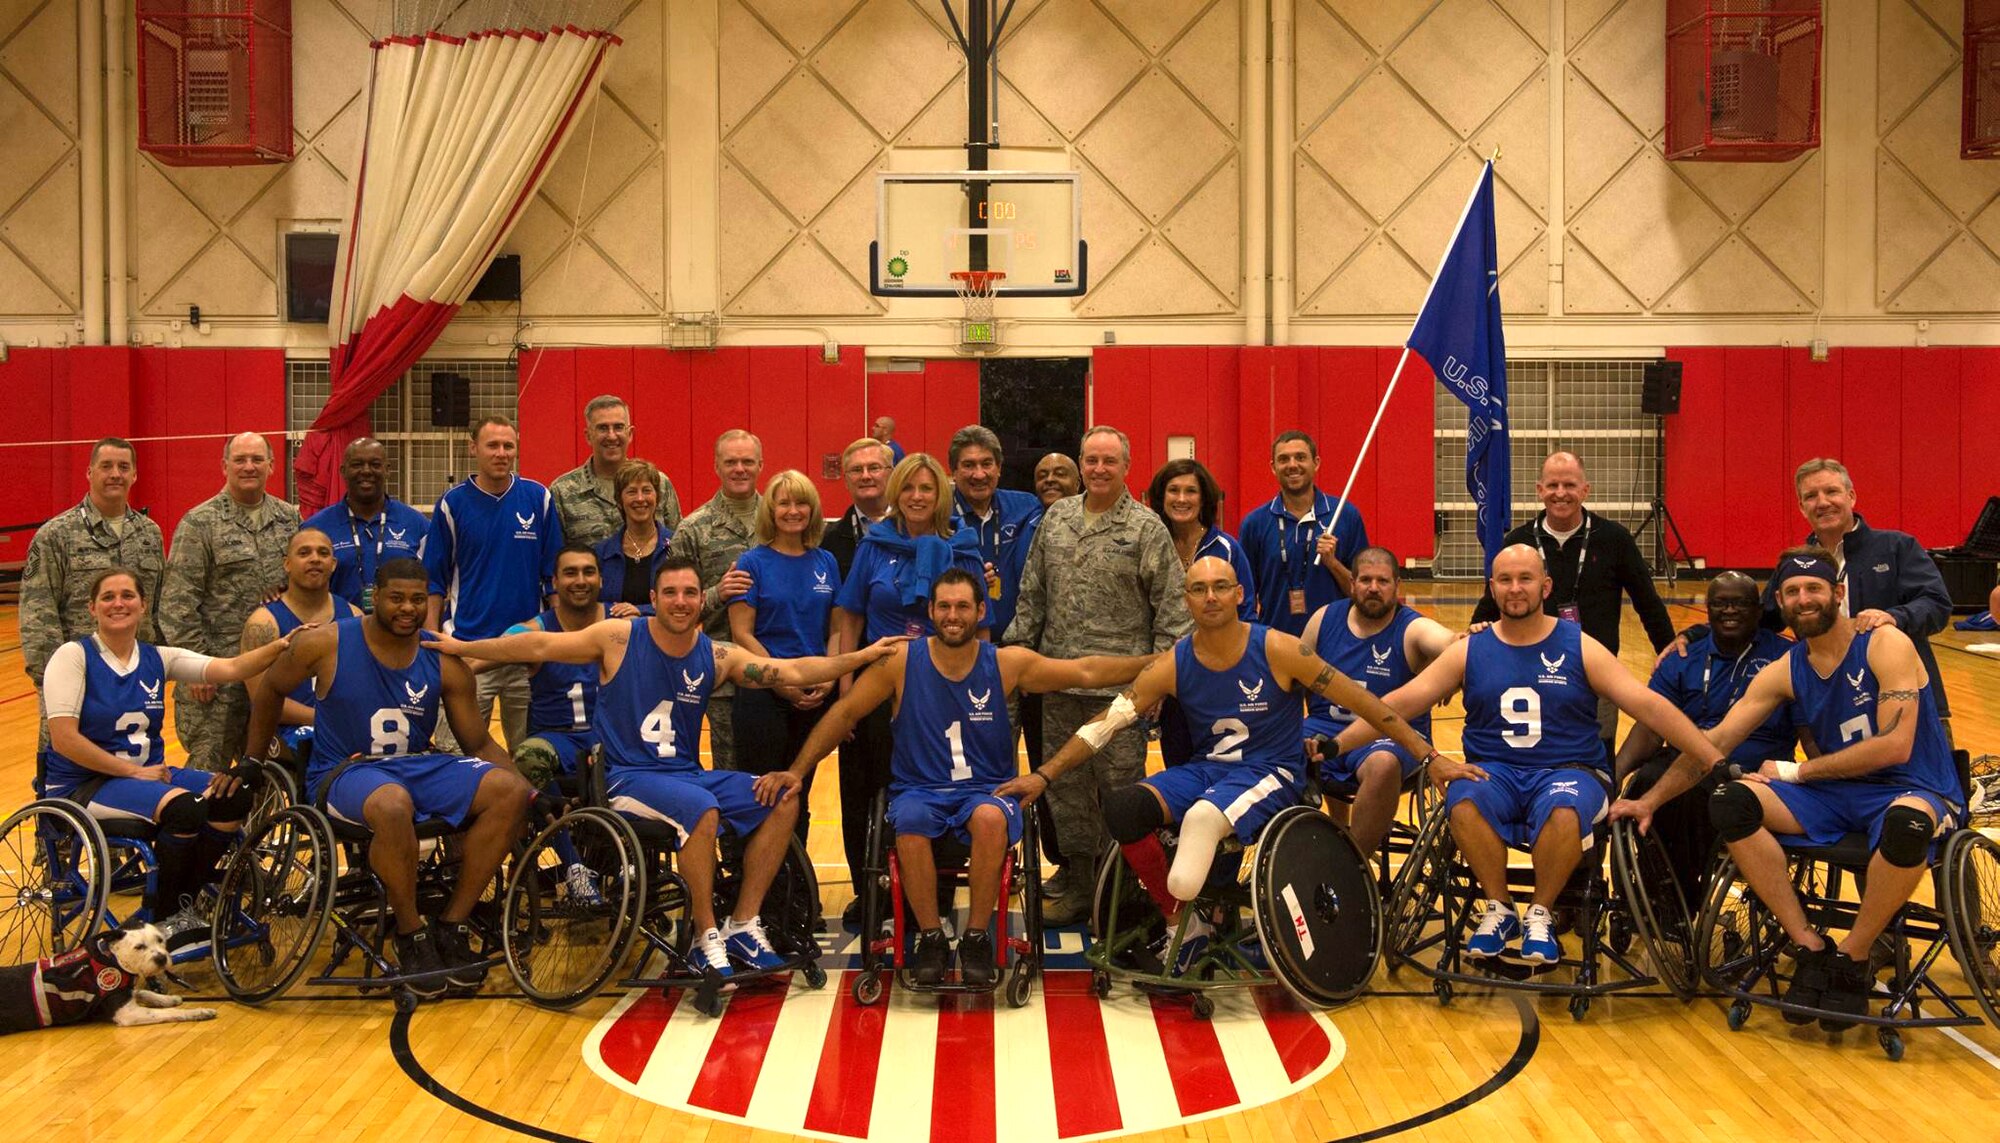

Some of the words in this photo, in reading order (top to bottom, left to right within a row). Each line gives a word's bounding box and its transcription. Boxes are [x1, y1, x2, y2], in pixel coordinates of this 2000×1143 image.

[1055, 269, 1071, 278] USA
[1443, 355, 1489, 406] U.S.
[115, 711, 151, 767] 3
[371, 708, 410, 754] 8
[640, 700, 677, 758] 4
[1206, 717, 1250, 762] 2
[1500, 687, 1542, 748] 9
[945, 721, 973, 782] 1
